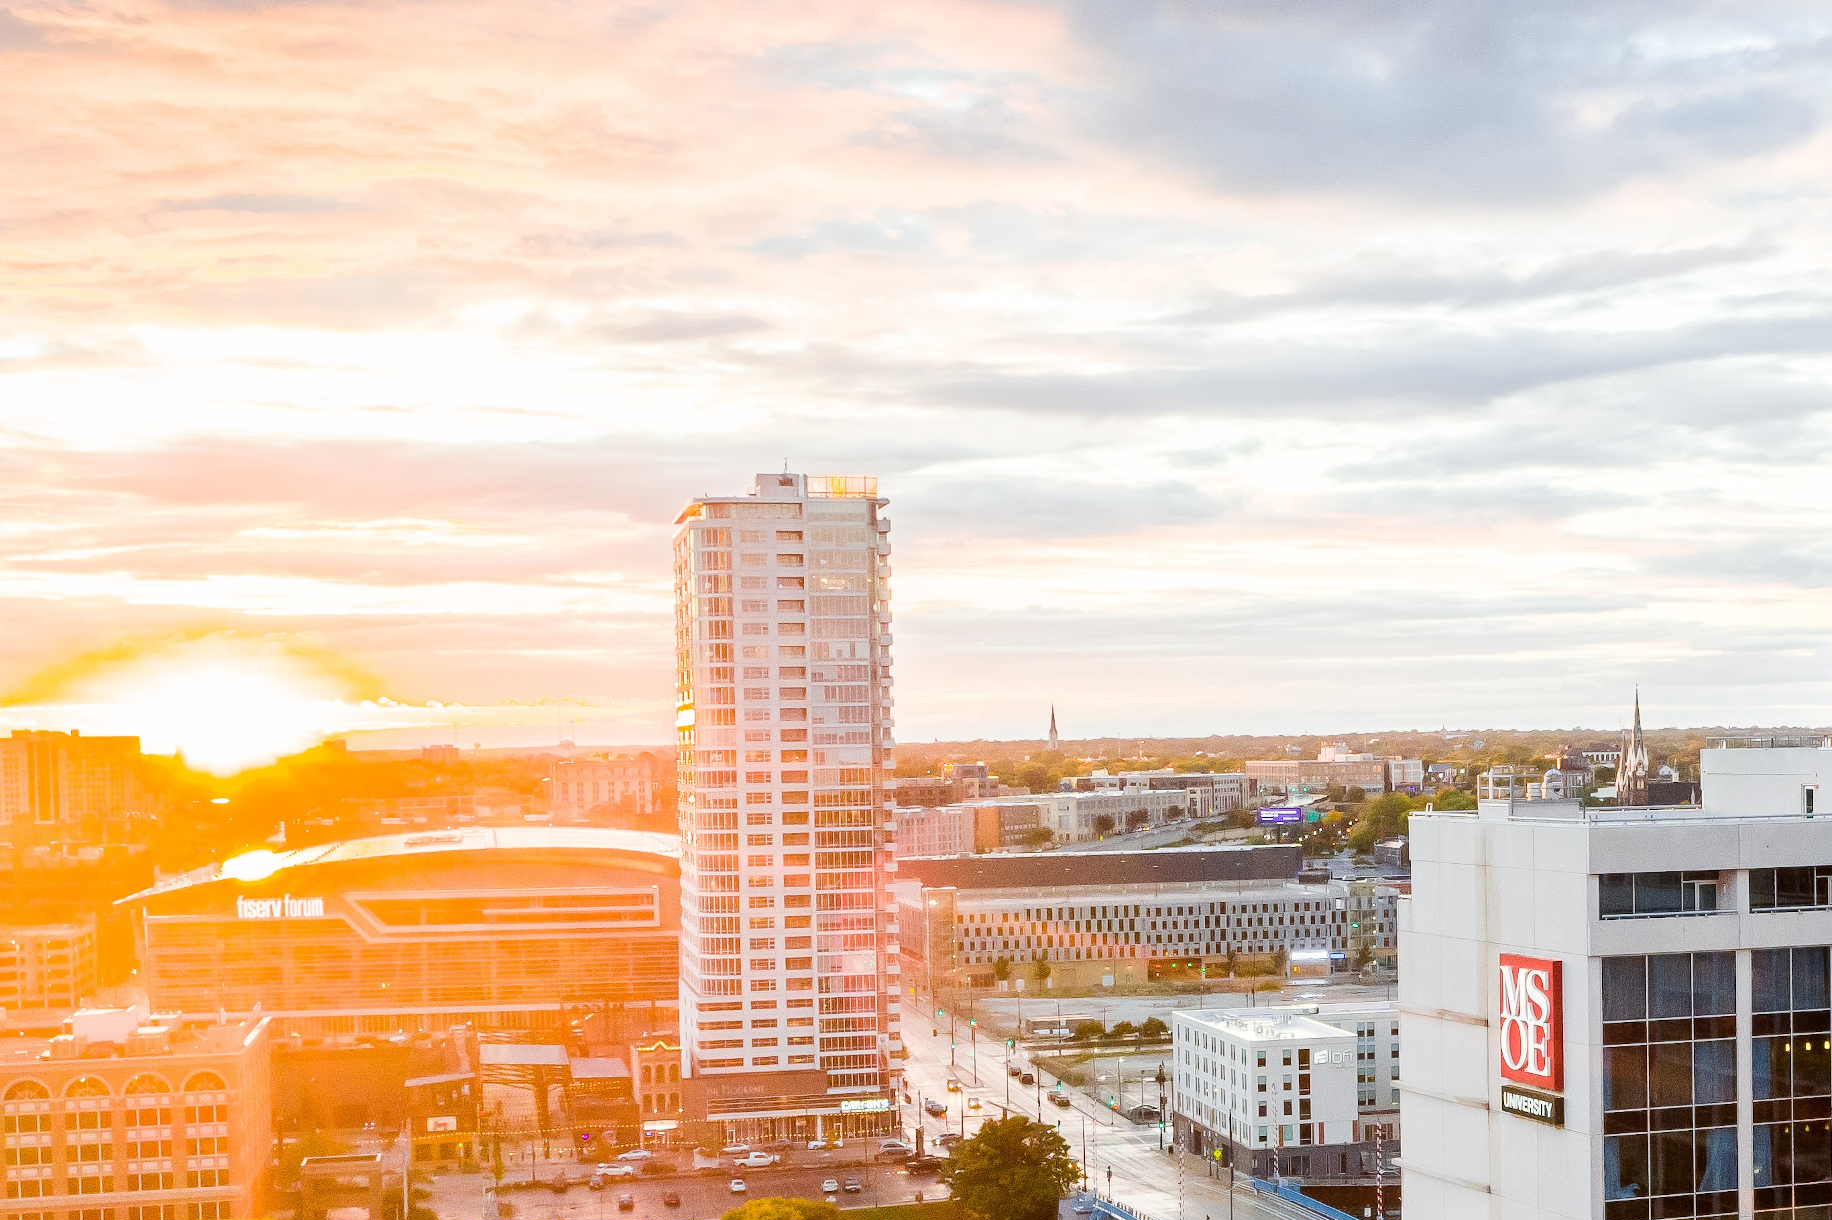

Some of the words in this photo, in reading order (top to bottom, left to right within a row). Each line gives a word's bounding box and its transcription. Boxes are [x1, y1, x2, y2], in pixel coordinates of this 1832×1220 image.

[237, 895, 281, 918] fiserv
[284, 893, 324, 917] forum
[1504, 1092, 1552, 1118] UNIVERSITY
